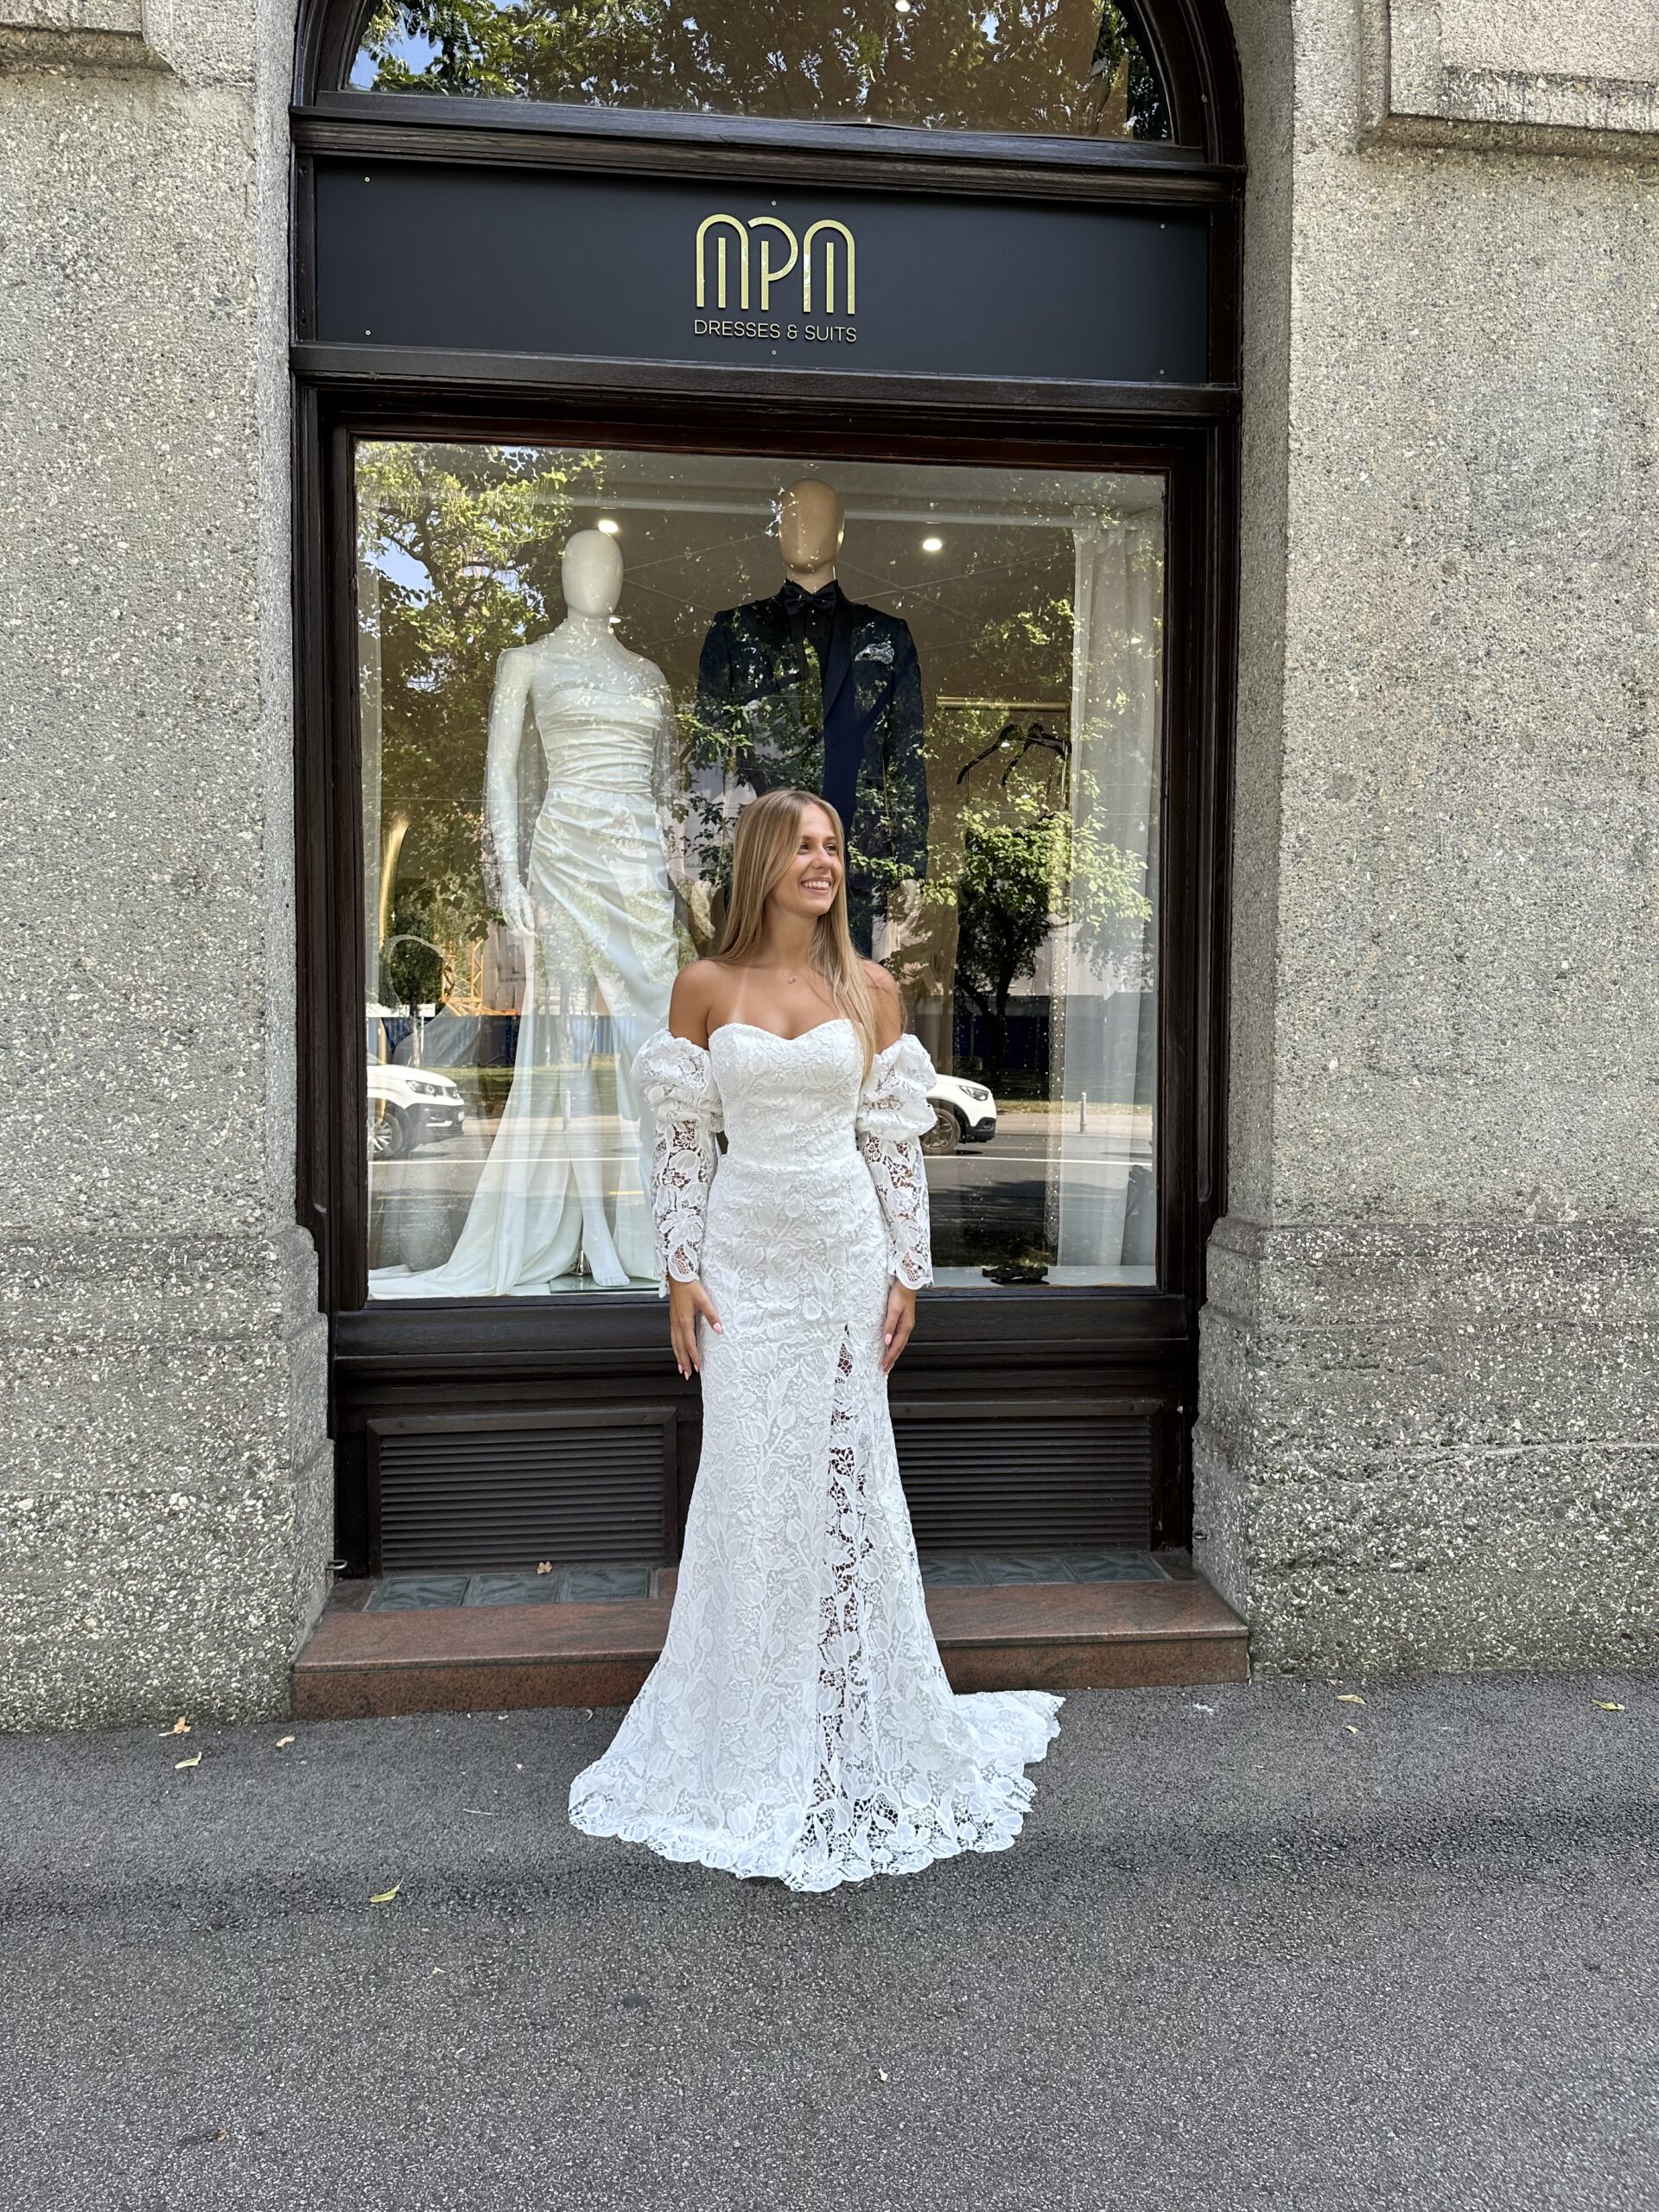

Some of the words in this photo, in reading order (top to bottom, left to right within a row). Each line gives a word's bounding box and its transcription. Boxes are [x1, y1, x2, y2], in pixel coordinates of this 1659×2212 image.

[696, 213, 855, 315] MPM
[694, 319, 781, 339] DRESSES
[786, 324, 798, 340] &
[804, 325, 857, 342] SUITS
